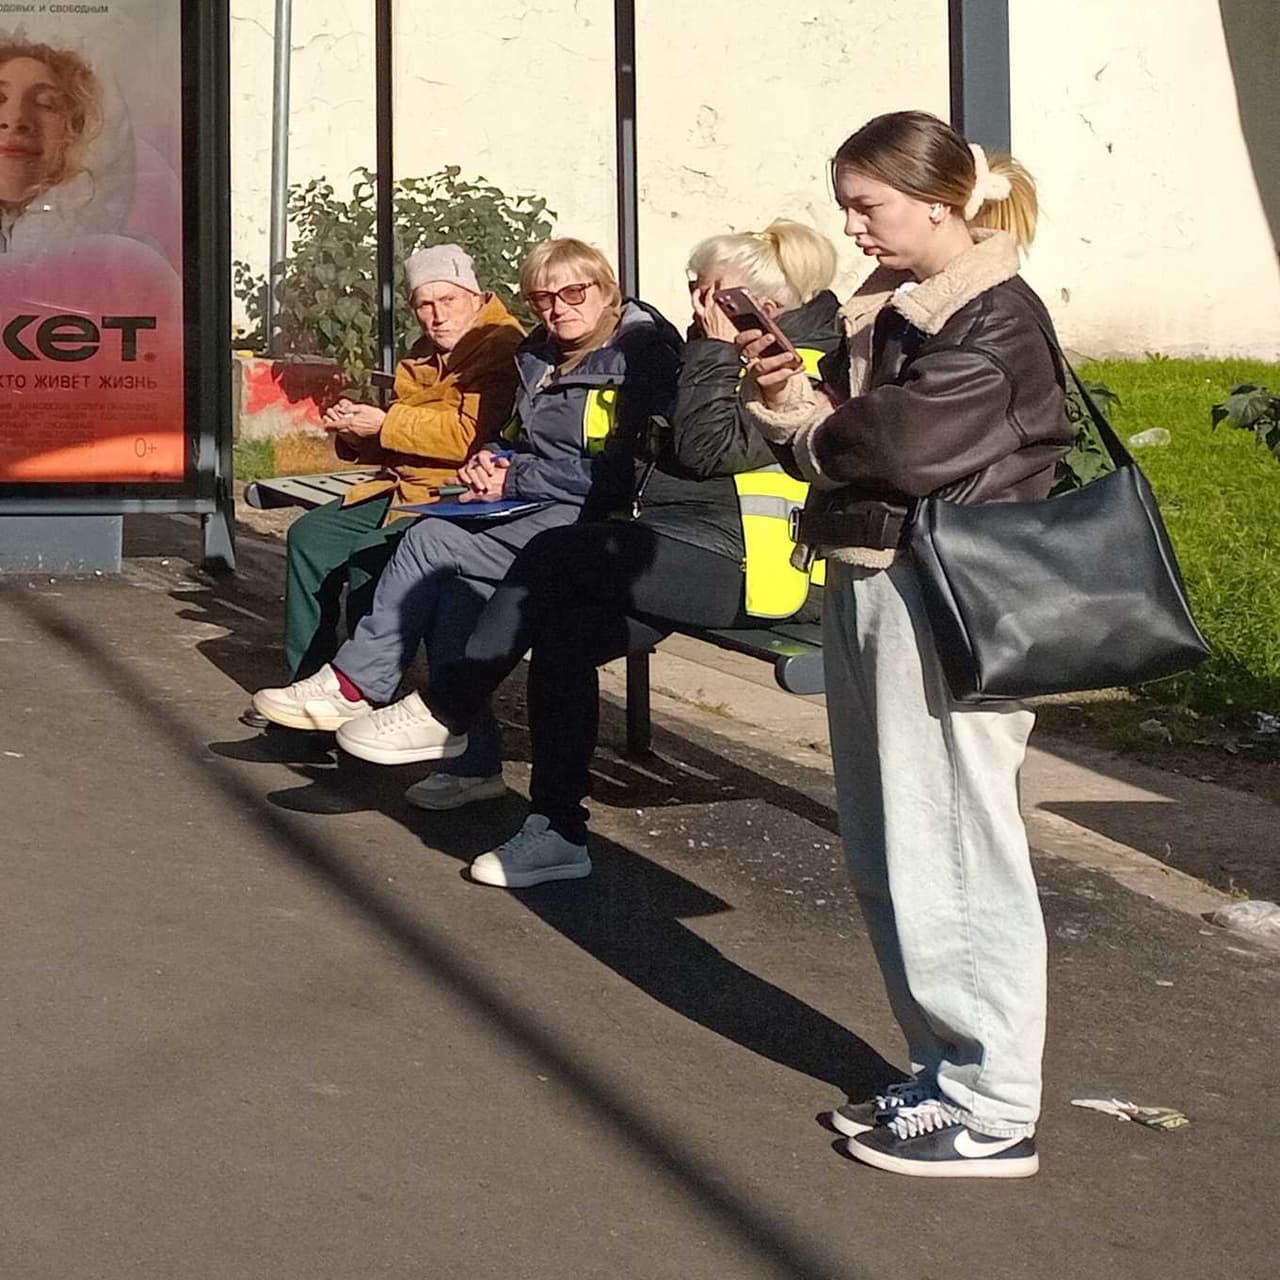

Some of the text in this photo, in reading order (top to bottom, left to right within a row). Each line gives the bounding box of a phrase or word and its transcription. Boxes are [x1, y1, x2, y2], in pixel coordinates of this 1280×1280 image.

[39, 4, 46, 12] И
[49, 4, 109, 13] СВОБОДНЫМ
[99, 375, 158, 389] ЖИЗНЬ
[135, 437, 157, 457] 0+
